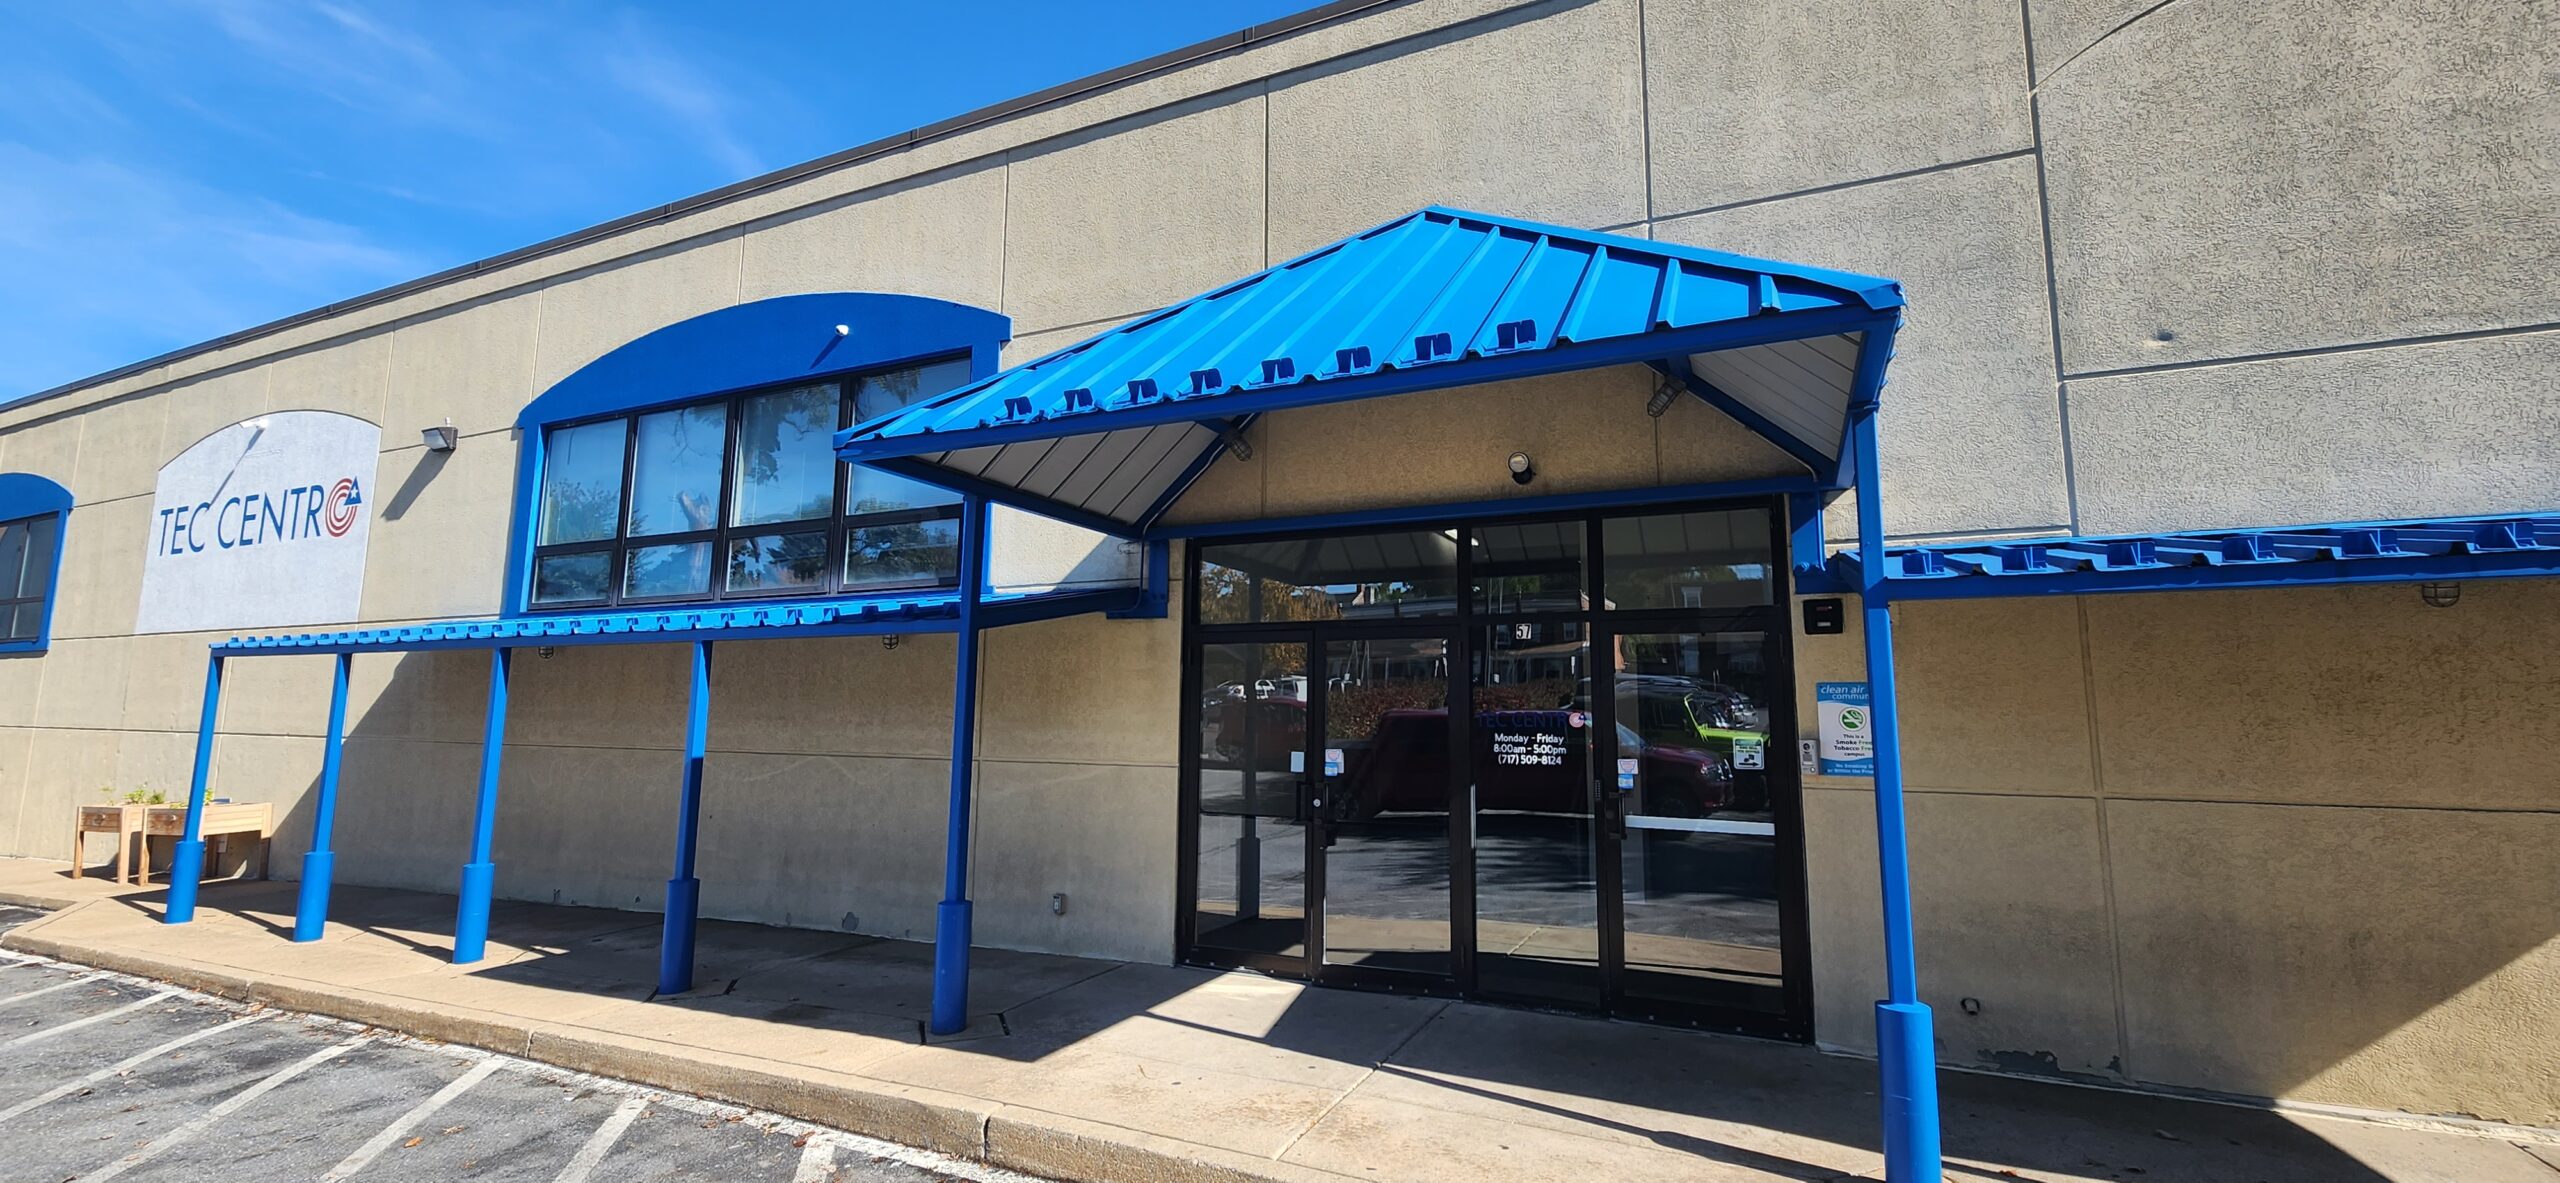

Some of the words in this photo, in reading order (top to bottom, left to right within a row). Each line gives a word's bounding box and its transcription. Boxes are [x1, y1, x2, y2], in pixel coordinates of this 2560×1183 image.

[159, 502, 211, 557] TEC
[1517, 624, 1531, 639] 57
[1821, 685, 1848, 693] clean
[1850, 685, 1865, 693] air
[1478, 711, 1504, 728] TEC
[1494, 733, 1529, 744] Monday
[1536, 733, 1564, 745] Friday
[1493, 743, 1526, 753] 8:00am
[1533, 744, 1567, 755] 5:00pm
[1498, 754, 1519, 765] (717)
[1520, 754, 1562, 765] 509-8124
